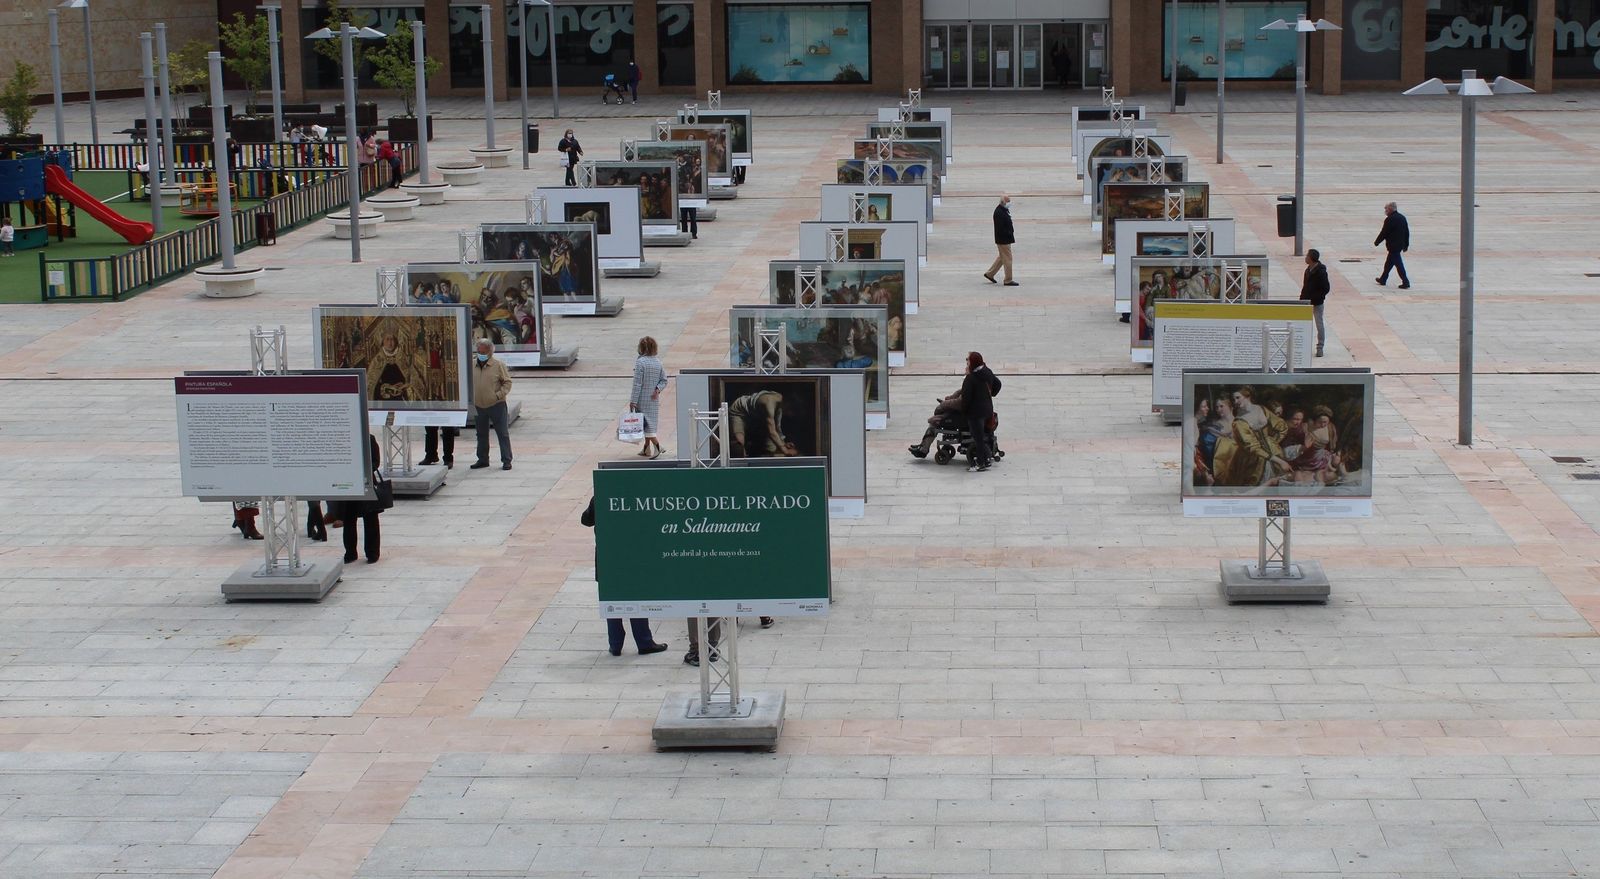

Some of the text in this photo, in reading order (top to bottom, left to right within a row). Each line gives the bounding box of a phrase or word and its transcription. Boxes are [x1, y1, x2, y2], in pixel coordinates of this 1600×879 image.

[608, 494, 811, 511] EL MUSEO DEL PRADO
[661, 517, 761, 534] en Salamanca
[679, 549, 695, 557] abril
[695, 549, 702, 557] al
[702, 550, 709, 558] 31
